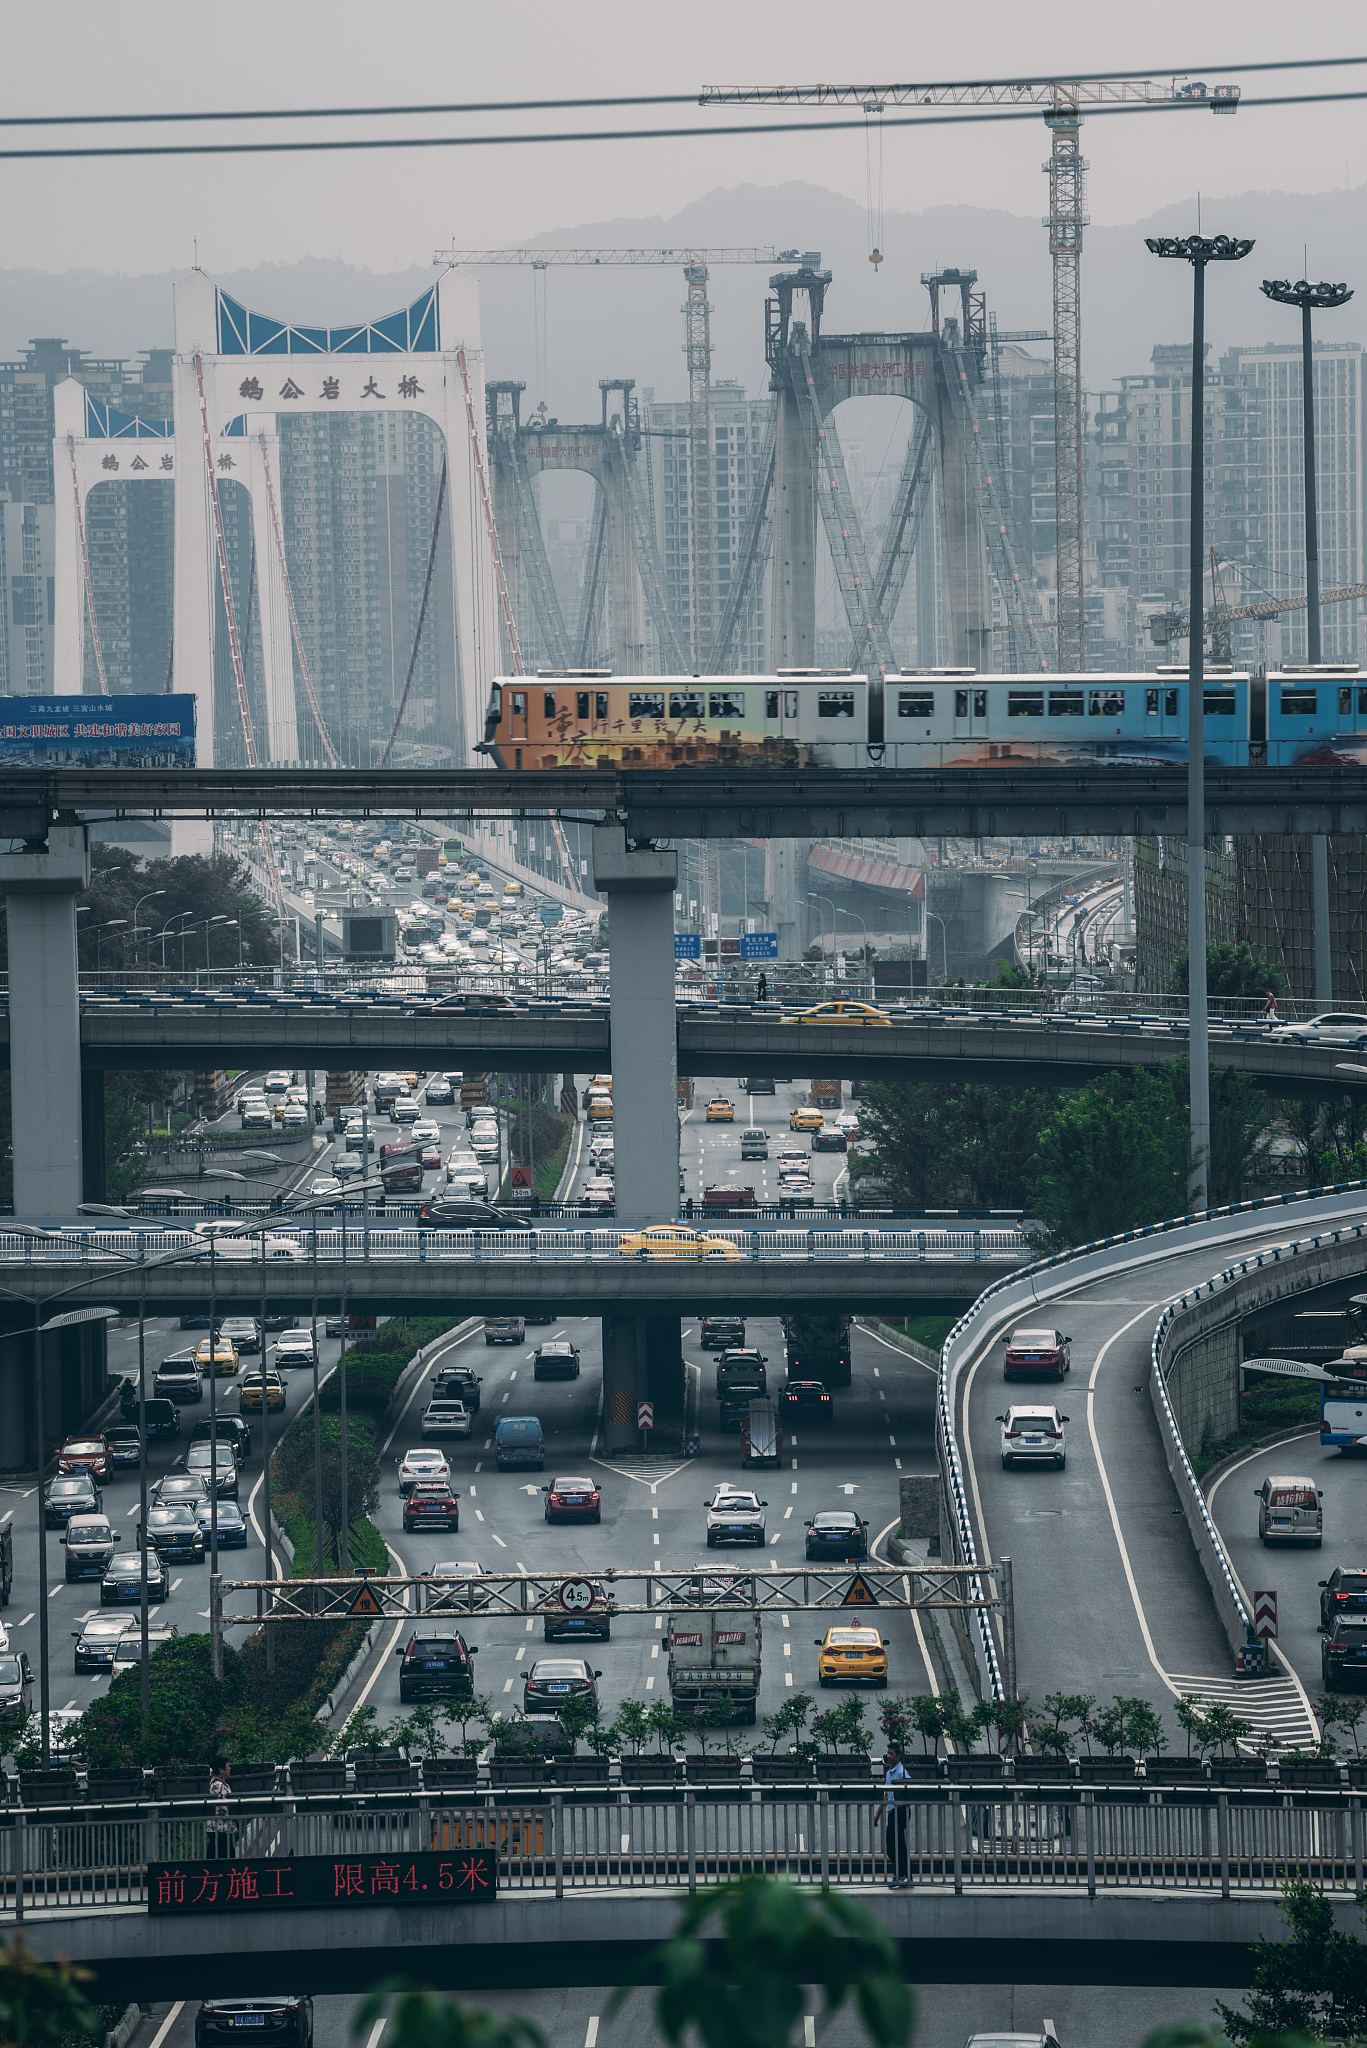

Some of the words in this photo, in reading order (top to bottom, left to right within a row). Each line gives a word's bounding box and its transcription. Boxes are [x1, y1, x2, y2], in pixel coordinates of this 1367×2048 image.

[828, 360, 925, 380] 中国铁建大桥工程局
[239, 375, 425, 400] 鹅公岩大桥
[528, 445, 599, 459] 中国铁建大桥工程局
[30, 705, 70, 713] 三高九龙坡
[74, 722, 181, 738] 共建和谐美好家园
[547, 705, 594, 761] 重庆
[592, 718, 643, 734] 行千里
[653, 717, 707, 736] 致广大
[1353, 1369, 1366, 1377] 823
[1276, 1492, 1305, 1507] 货拉拉
[566, 1588, 589, 1602] 4.5m
[854, 1588, 865, 1600] 慢
[360, 1598, 371, 1610] 慢
[156, 1866, 295, 1905] 前方施工
[334, 1857, 490, 1897] 限高4.5米
